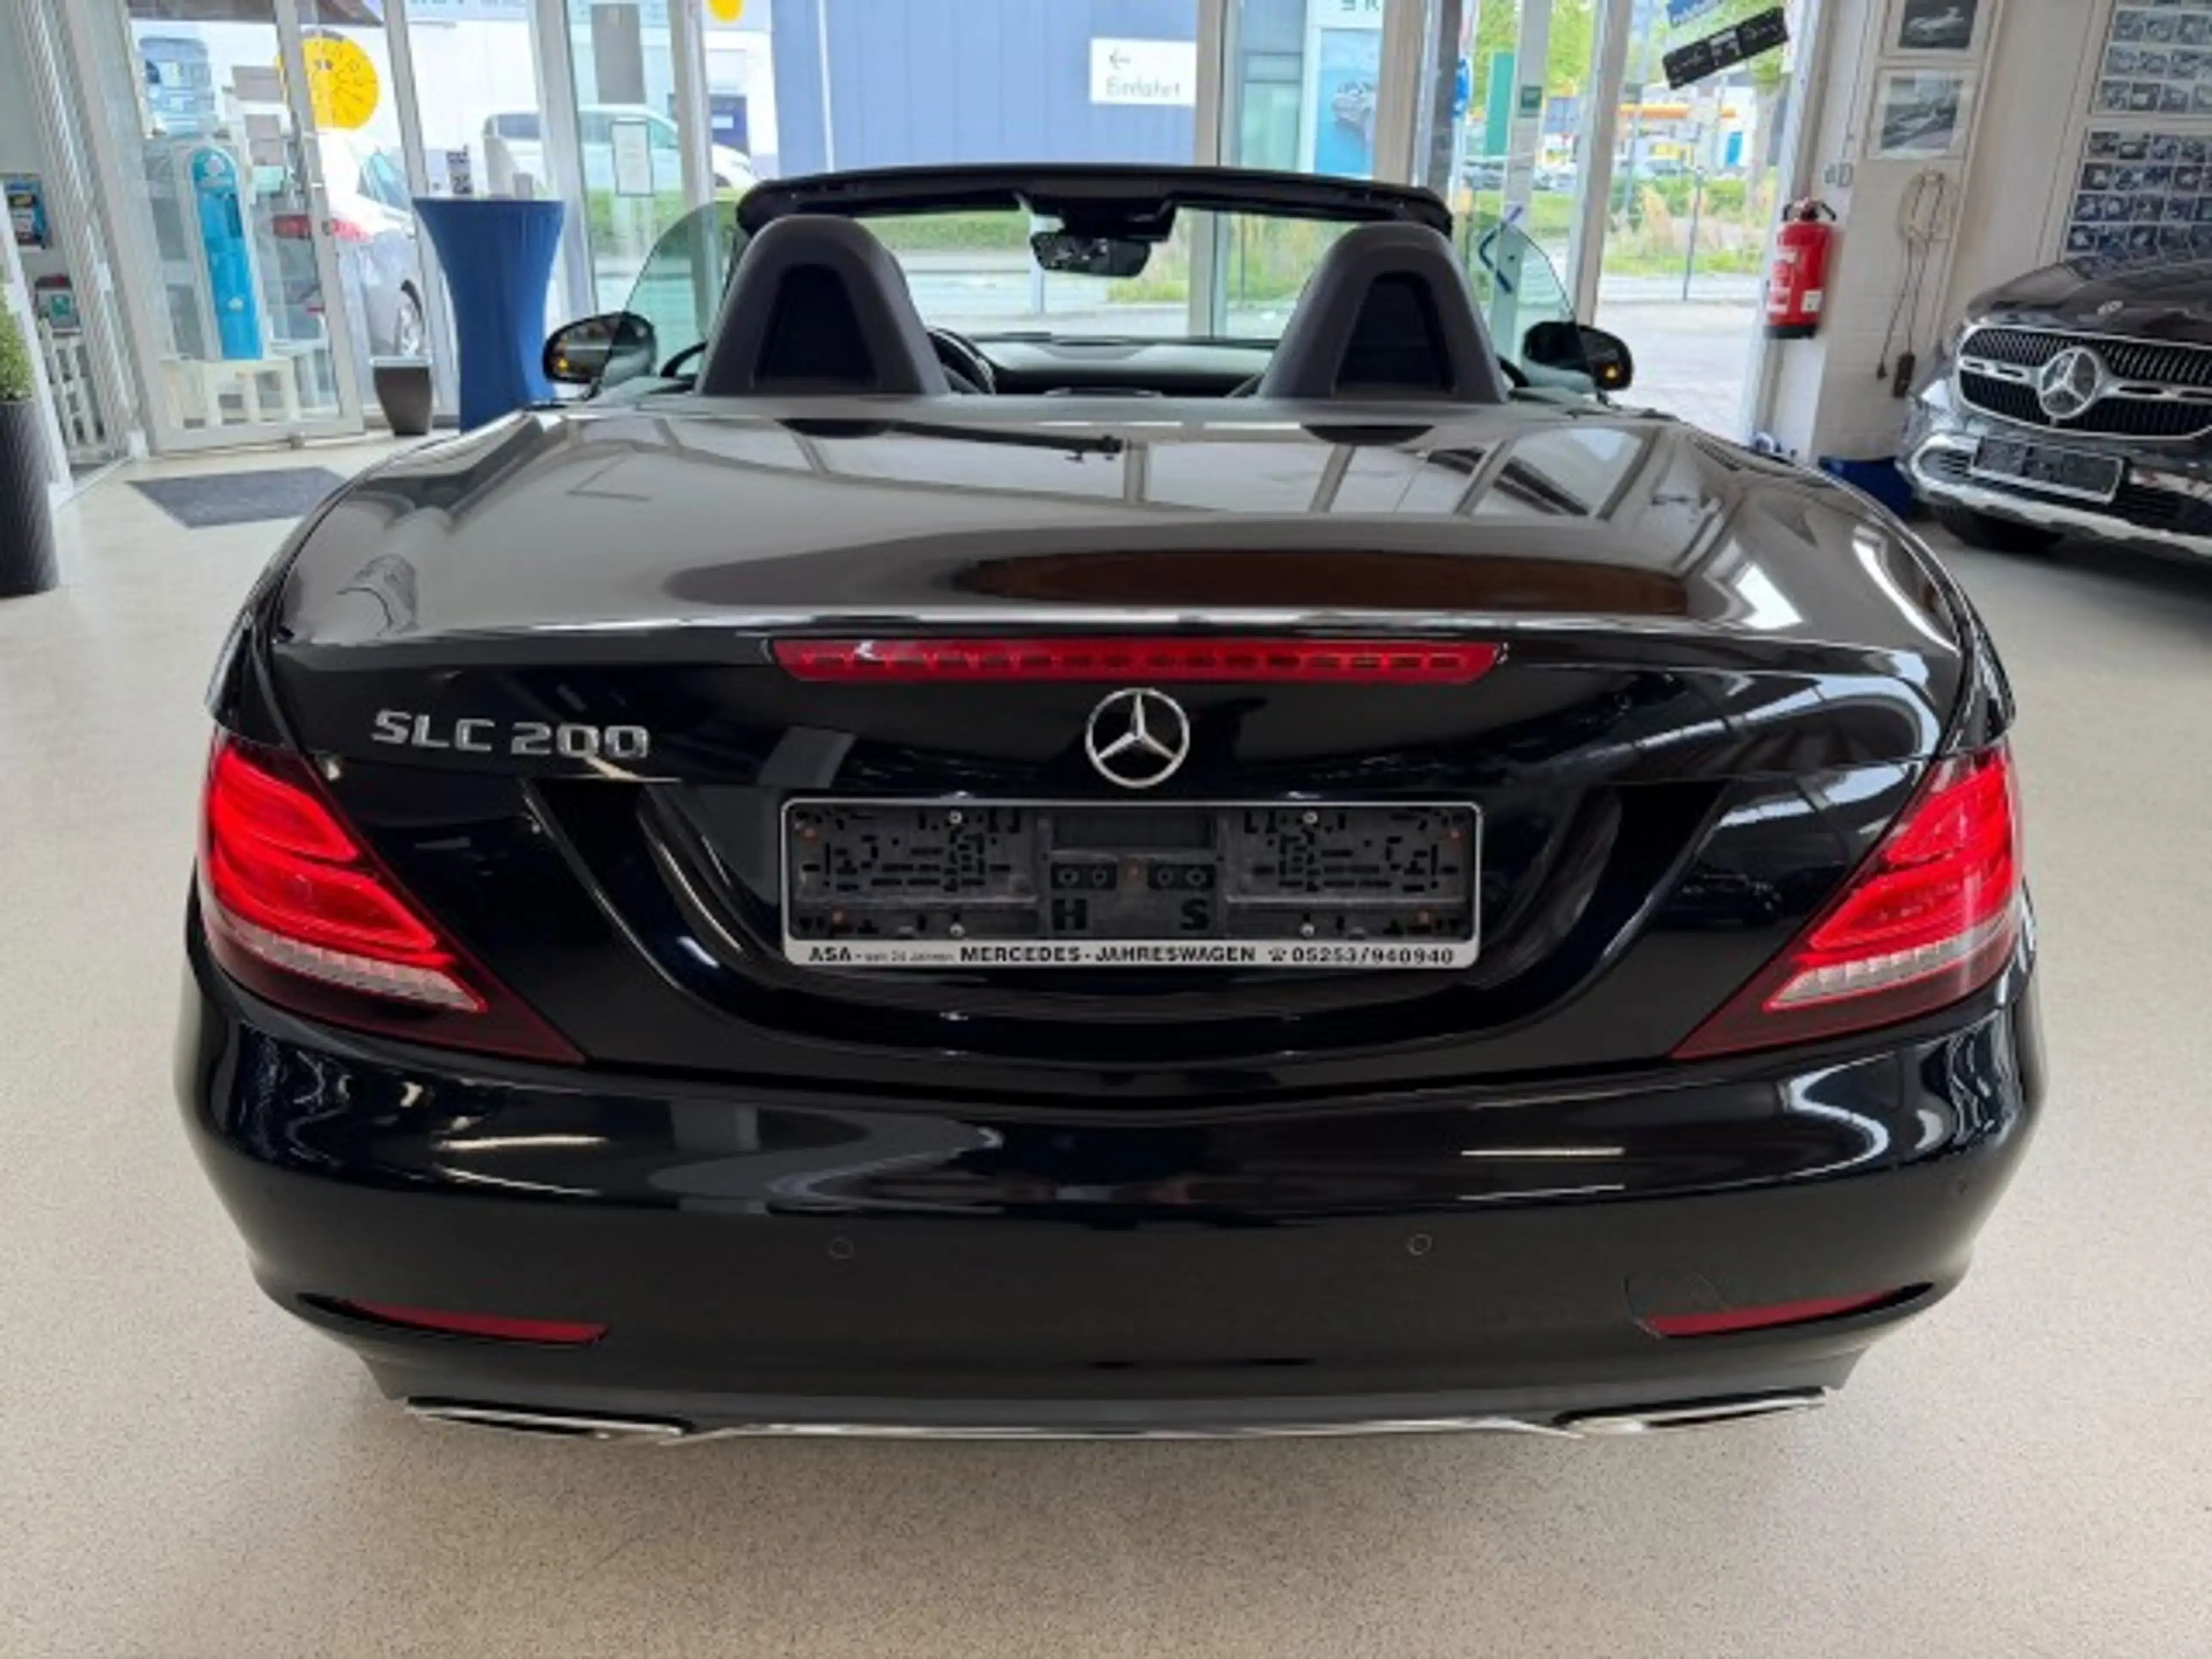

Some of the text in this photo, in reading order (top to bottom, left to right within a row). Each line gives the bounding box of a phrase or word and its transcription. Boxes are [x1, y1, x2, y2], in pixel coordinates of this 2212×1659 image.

[371, 708, 649, 758] SLC 200
[808, 946, 852, 962] ASA
[960, 946, 1080, 962] MERCEDES
[1096, 946, 1256, 962] JAHRESWAGEN
